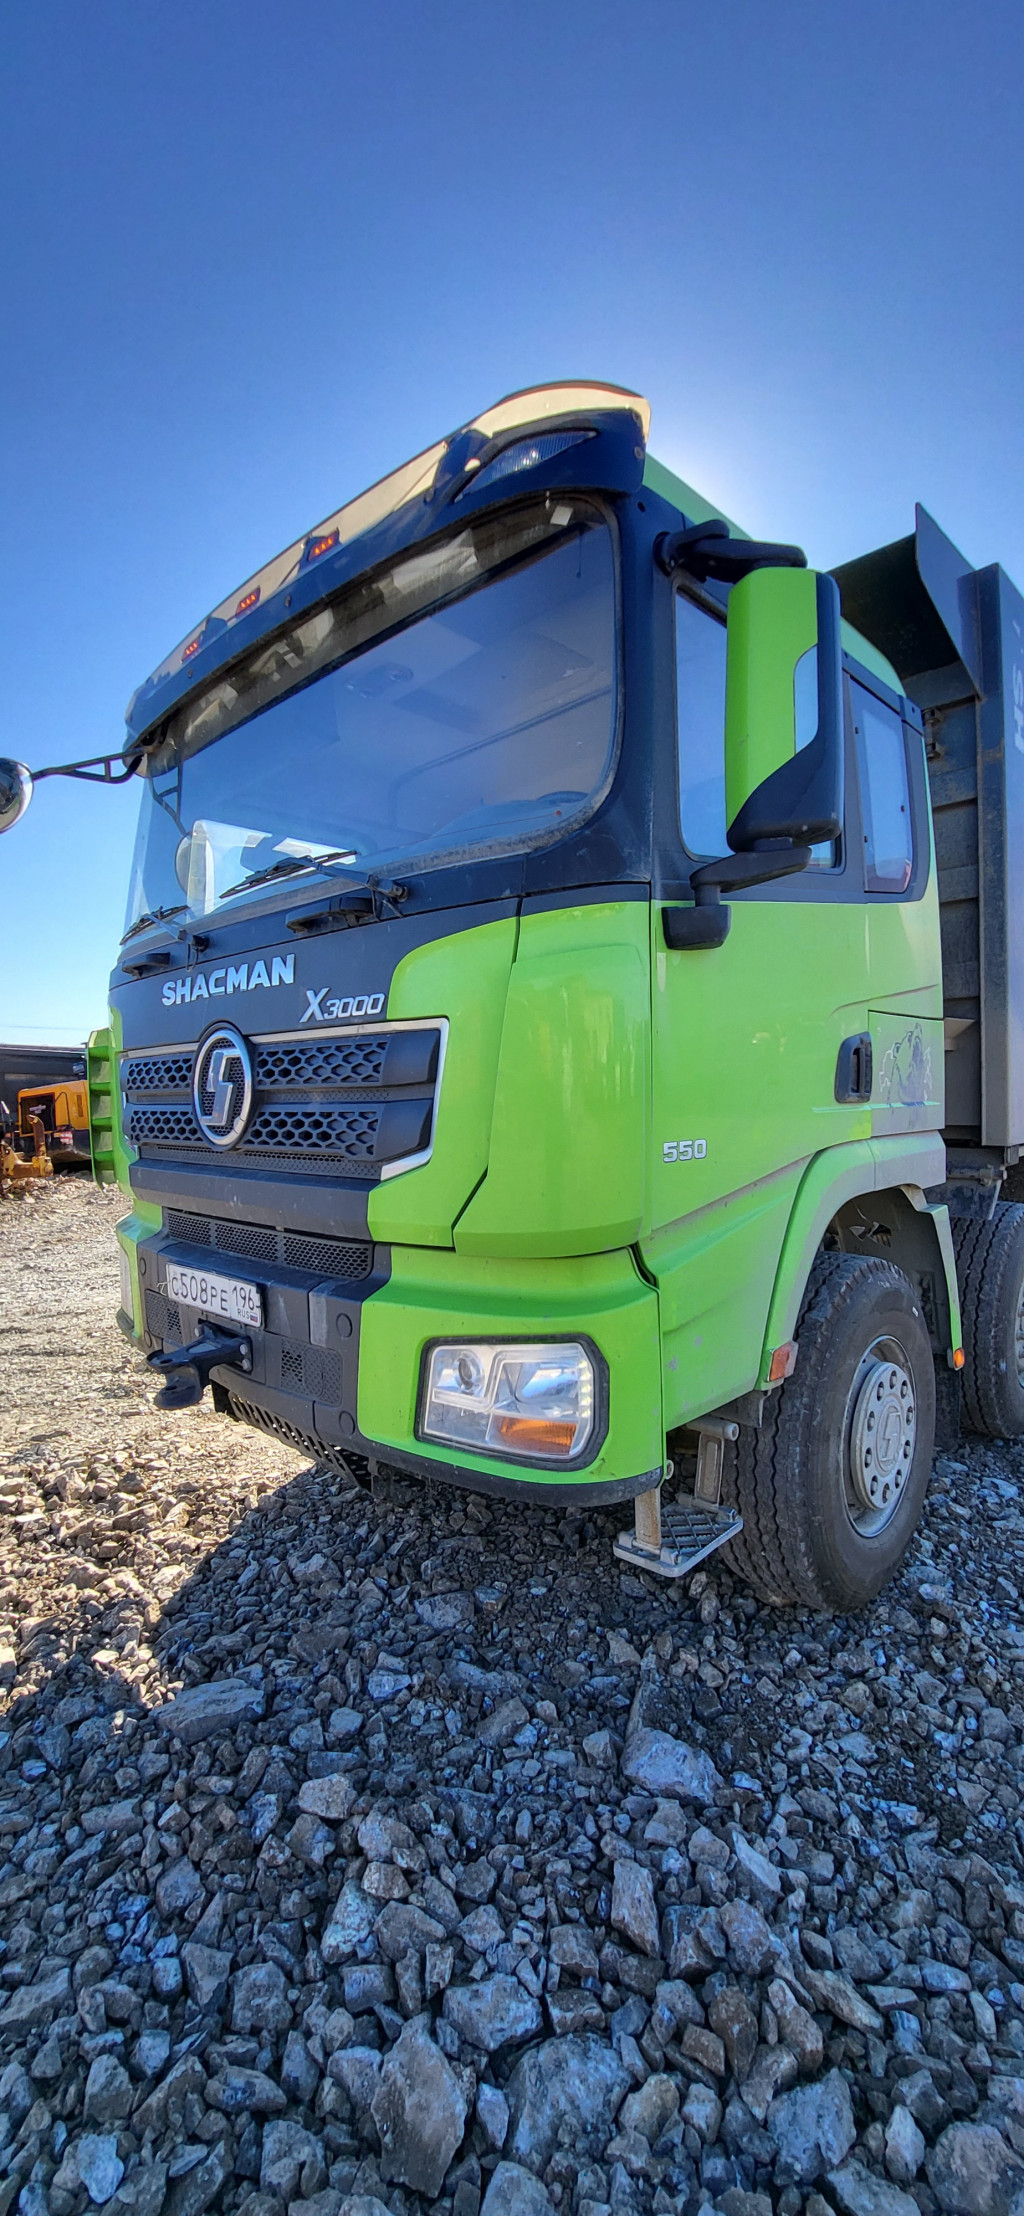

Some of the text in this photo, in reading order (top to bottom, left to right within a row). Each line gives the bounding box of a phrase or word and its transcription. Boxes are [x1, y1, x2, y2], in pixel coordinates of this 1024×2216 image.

[161, 953, 296, 1006] SHACMAN
[299, 987, 386, 1023] X3000
[663, 1138, 707, 1163] 550
[236, 1308, 250, 1319] RUS
